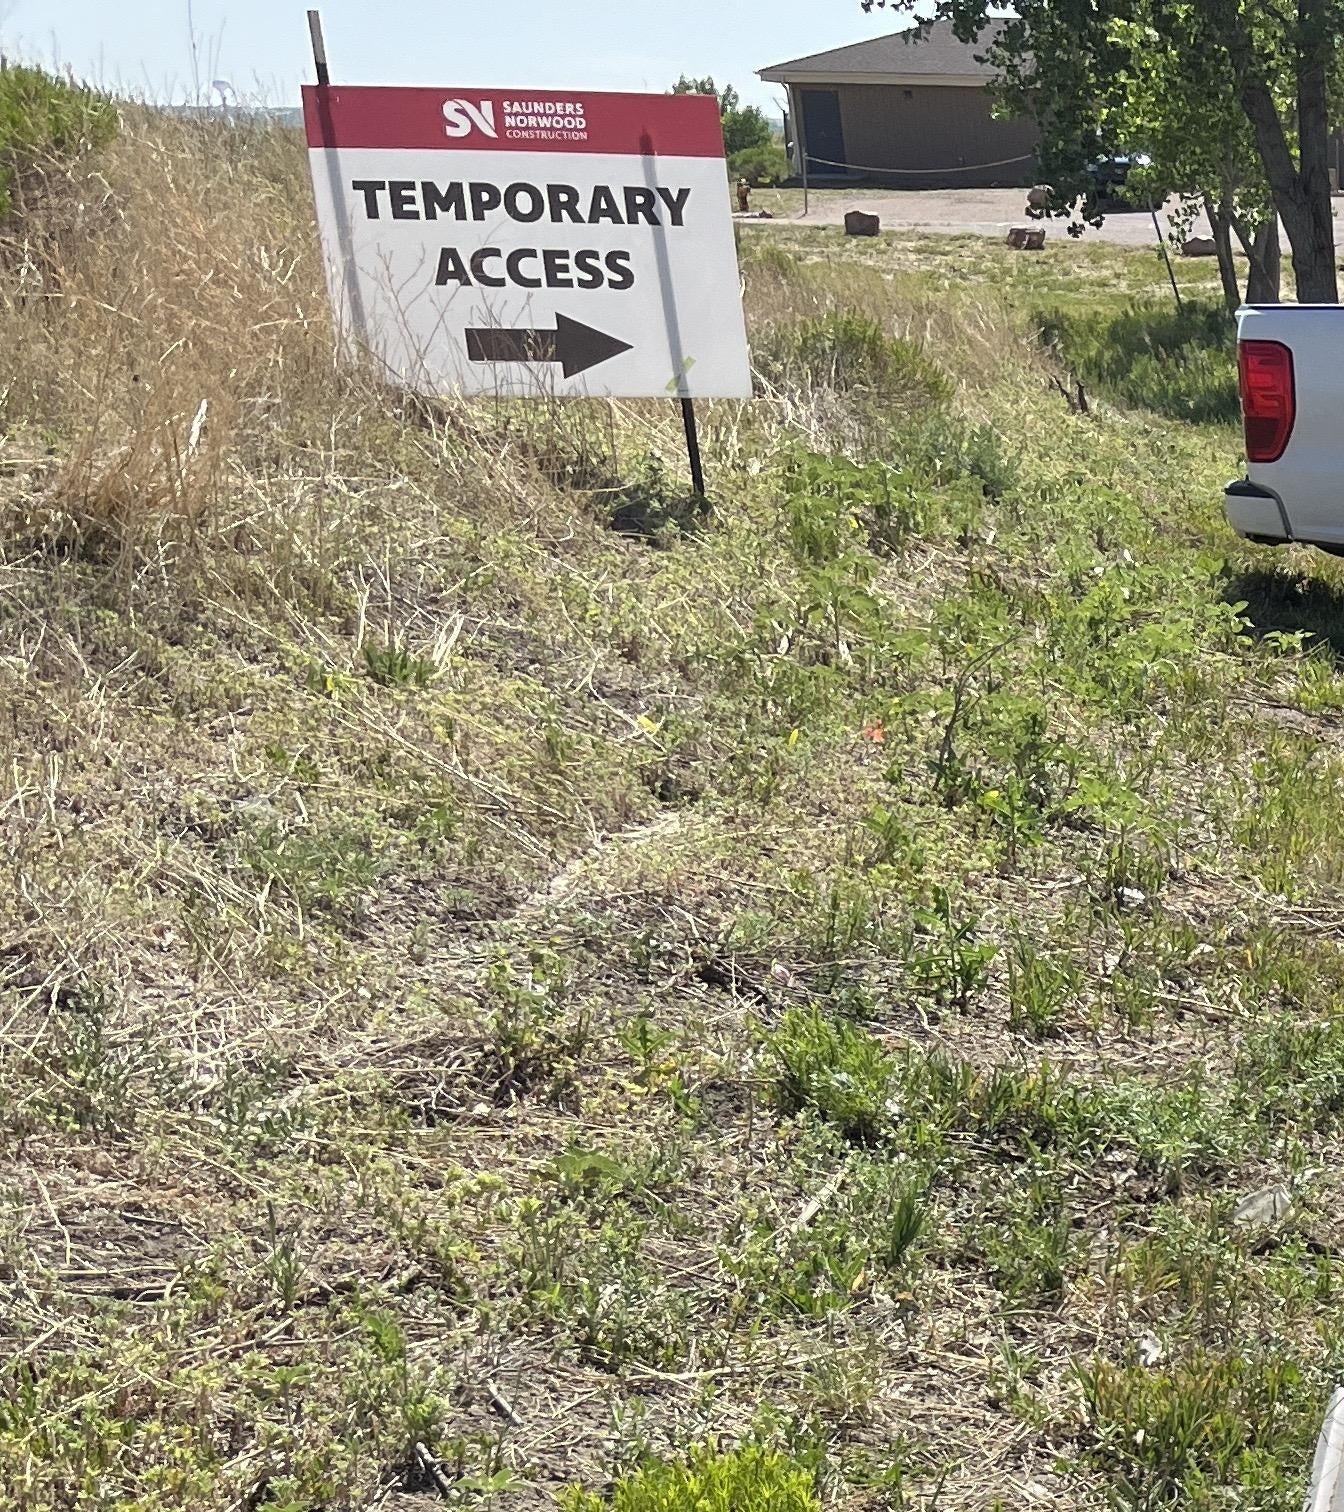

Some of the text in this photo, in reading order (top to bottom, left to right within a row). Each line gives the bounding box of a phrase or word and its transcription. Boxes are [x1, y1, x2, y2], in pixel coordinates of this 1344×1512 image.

[502, 101, 584, 115] SAUNDERS
[504, 115, 586, 129] NORWOOD
[505, 129, 588, 140] CONSTRUCTION
[352, 179, 691, 227] TEMPORARY
[435, 247, 635, 290] ACCESS
